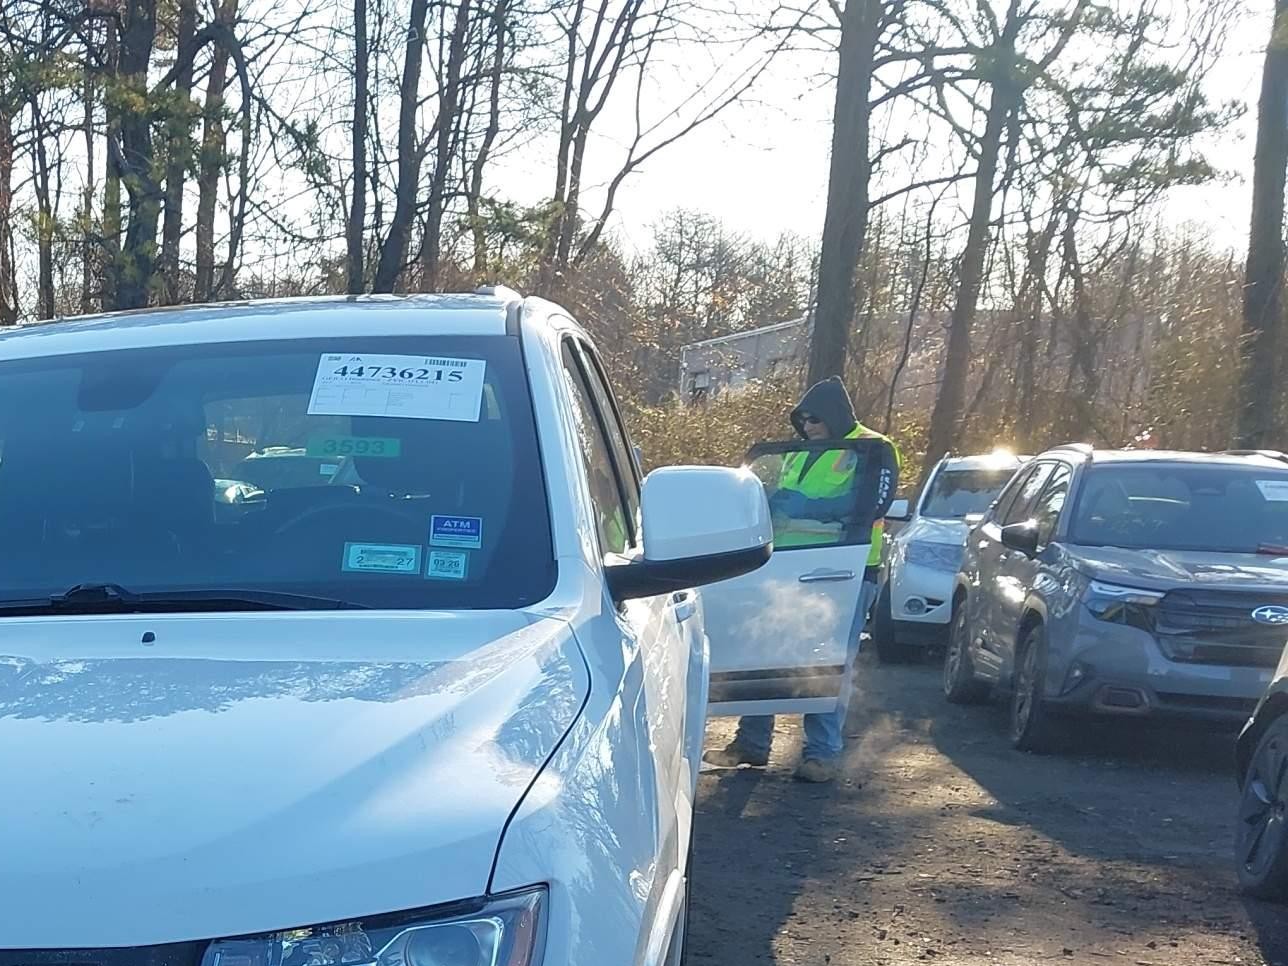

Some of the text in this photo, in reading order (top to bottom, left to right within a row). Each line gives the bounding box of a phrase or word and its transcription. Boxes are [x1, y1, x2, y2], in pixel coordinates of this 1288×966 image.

[332, 365, 464, 383] 44736215
[323, 439, 385, 455] 3593
[443, 519, 471, 529] ATM
[396, 558, 414, 567] 27
